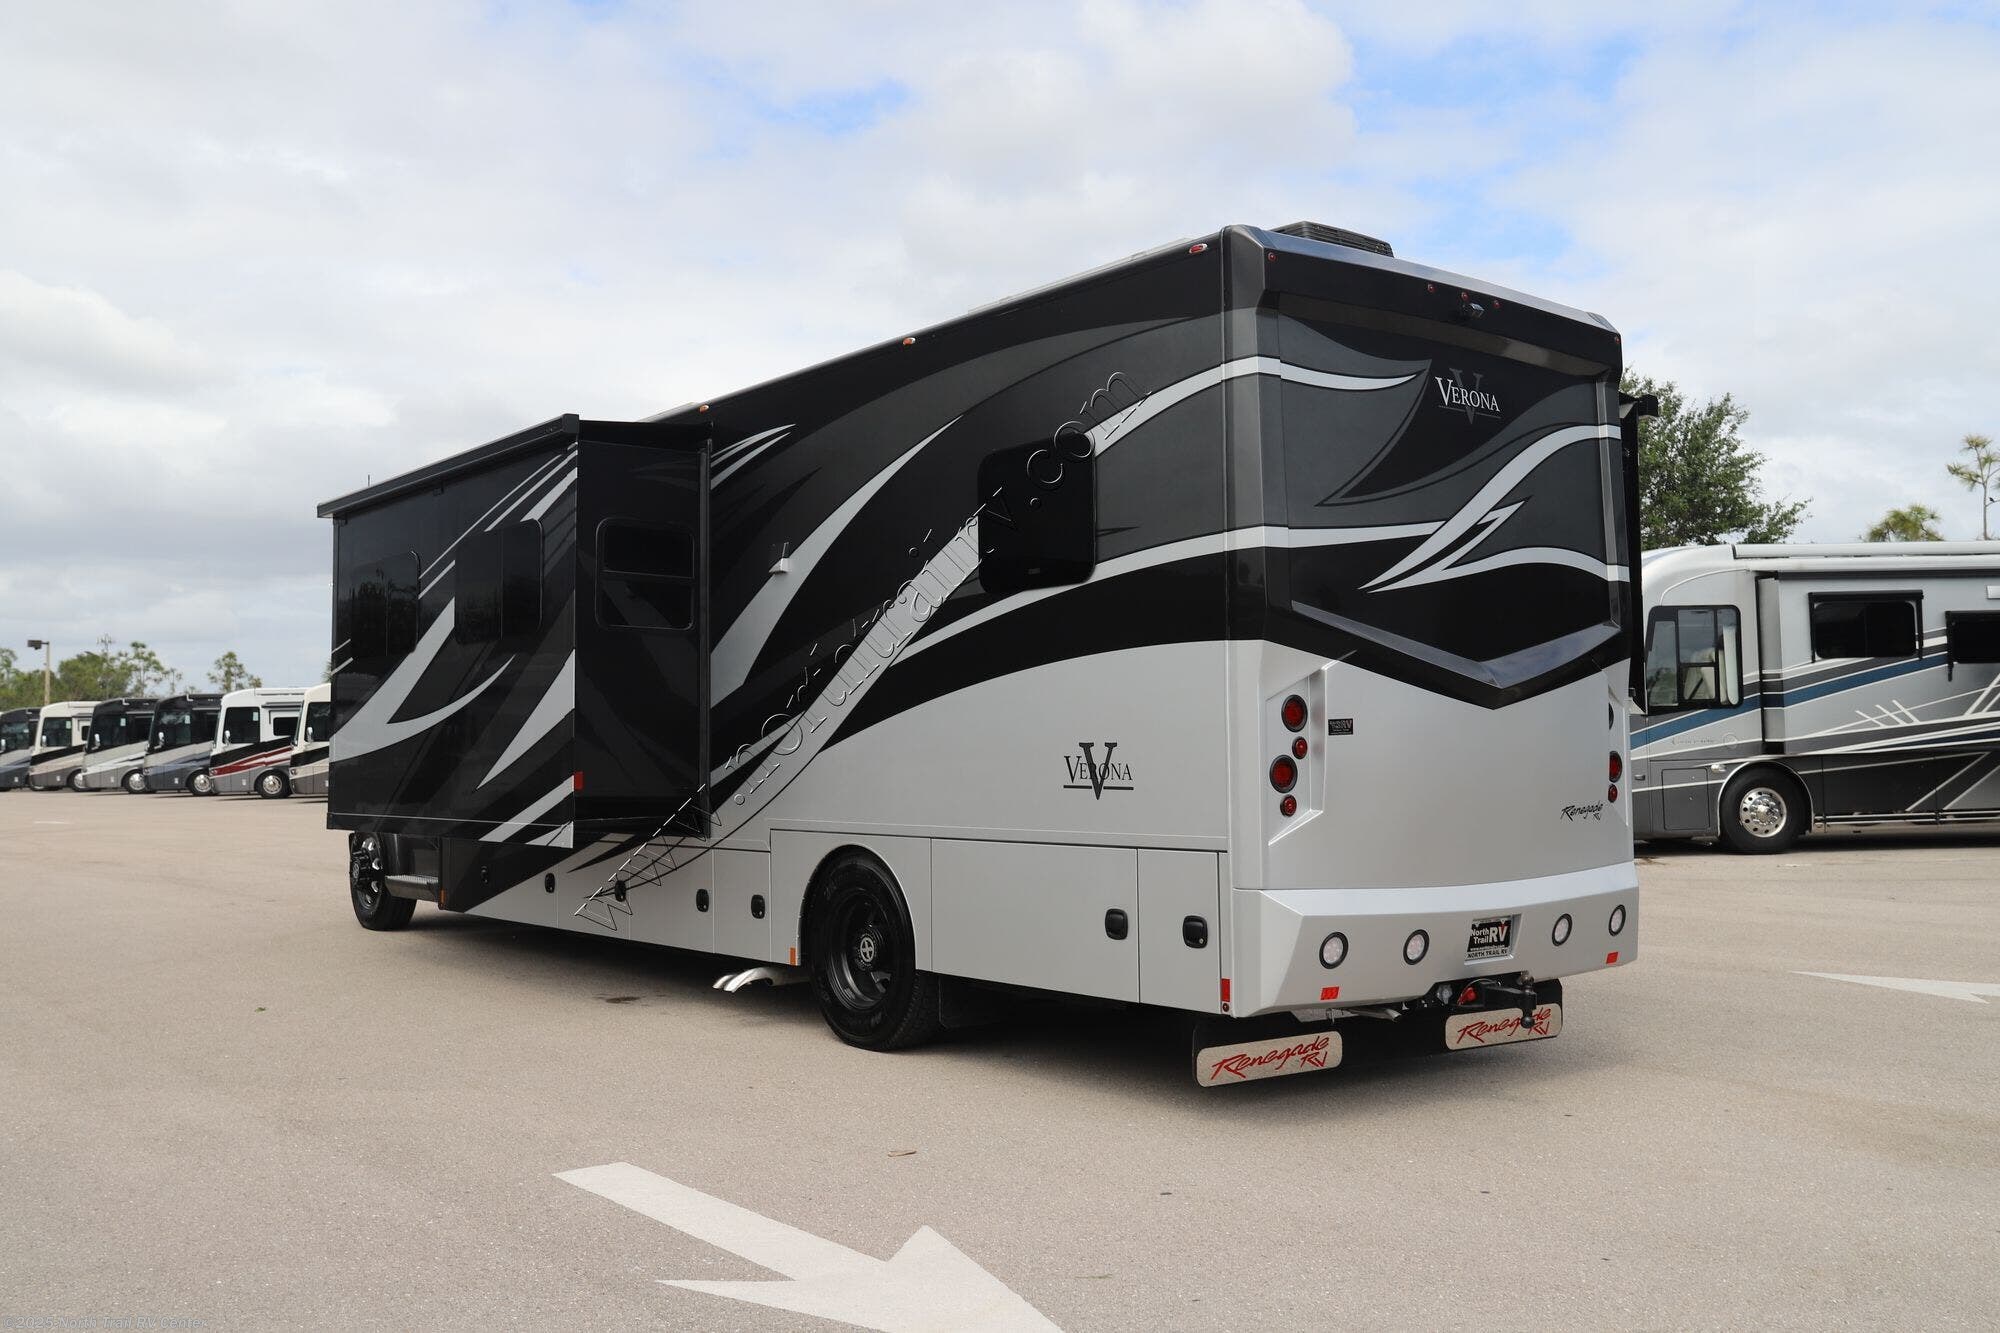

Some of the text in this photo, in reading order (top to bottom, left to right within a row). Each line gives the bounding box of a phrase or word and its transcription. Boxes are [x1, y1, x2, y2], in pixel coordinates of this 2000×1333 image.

[1434, 376, 1501, 412] VERONA
[1560, 800, 1604, 821] Renegade
[1470, 927, 1490, 937] North
[1473, 936, 1489, 944] Trail
[1489, 926, 1509, 943] RV
[1456, 1006, 1552, 1044] Renegde
[1210, 1035, 1330, 1080] Renegade
[1300, 1051, 1328, 1068] RV
